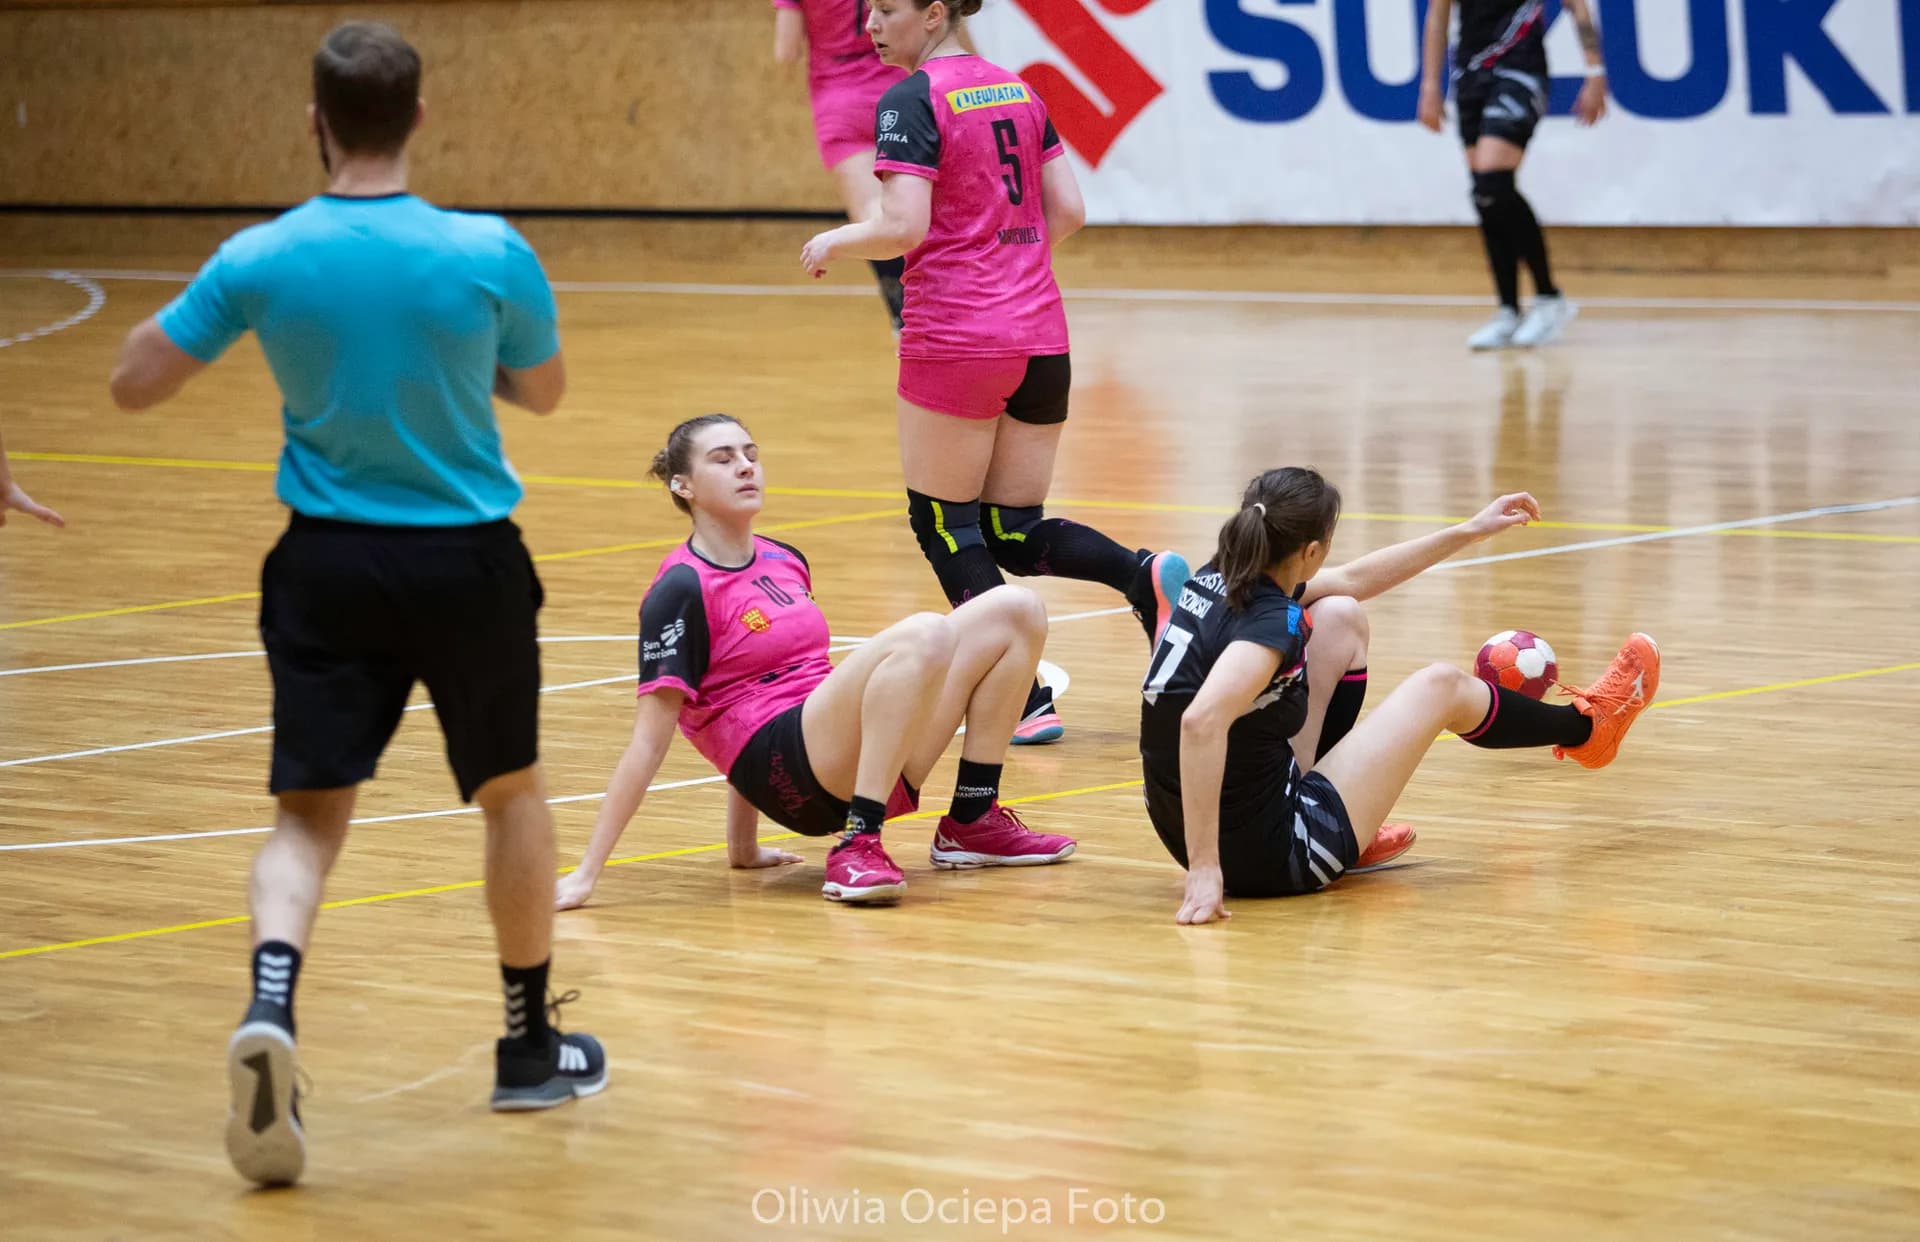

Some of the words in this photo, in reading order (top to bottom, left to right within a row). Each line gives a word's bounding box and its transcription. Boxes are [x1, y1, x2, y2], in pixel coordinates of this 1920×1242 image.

[969, 85, 1025, 106] LEWIATAN
[991, 117, 1023, 207] 5
[751, 575, 795, 608] 10
[643, 640, 661, 652] Sun
